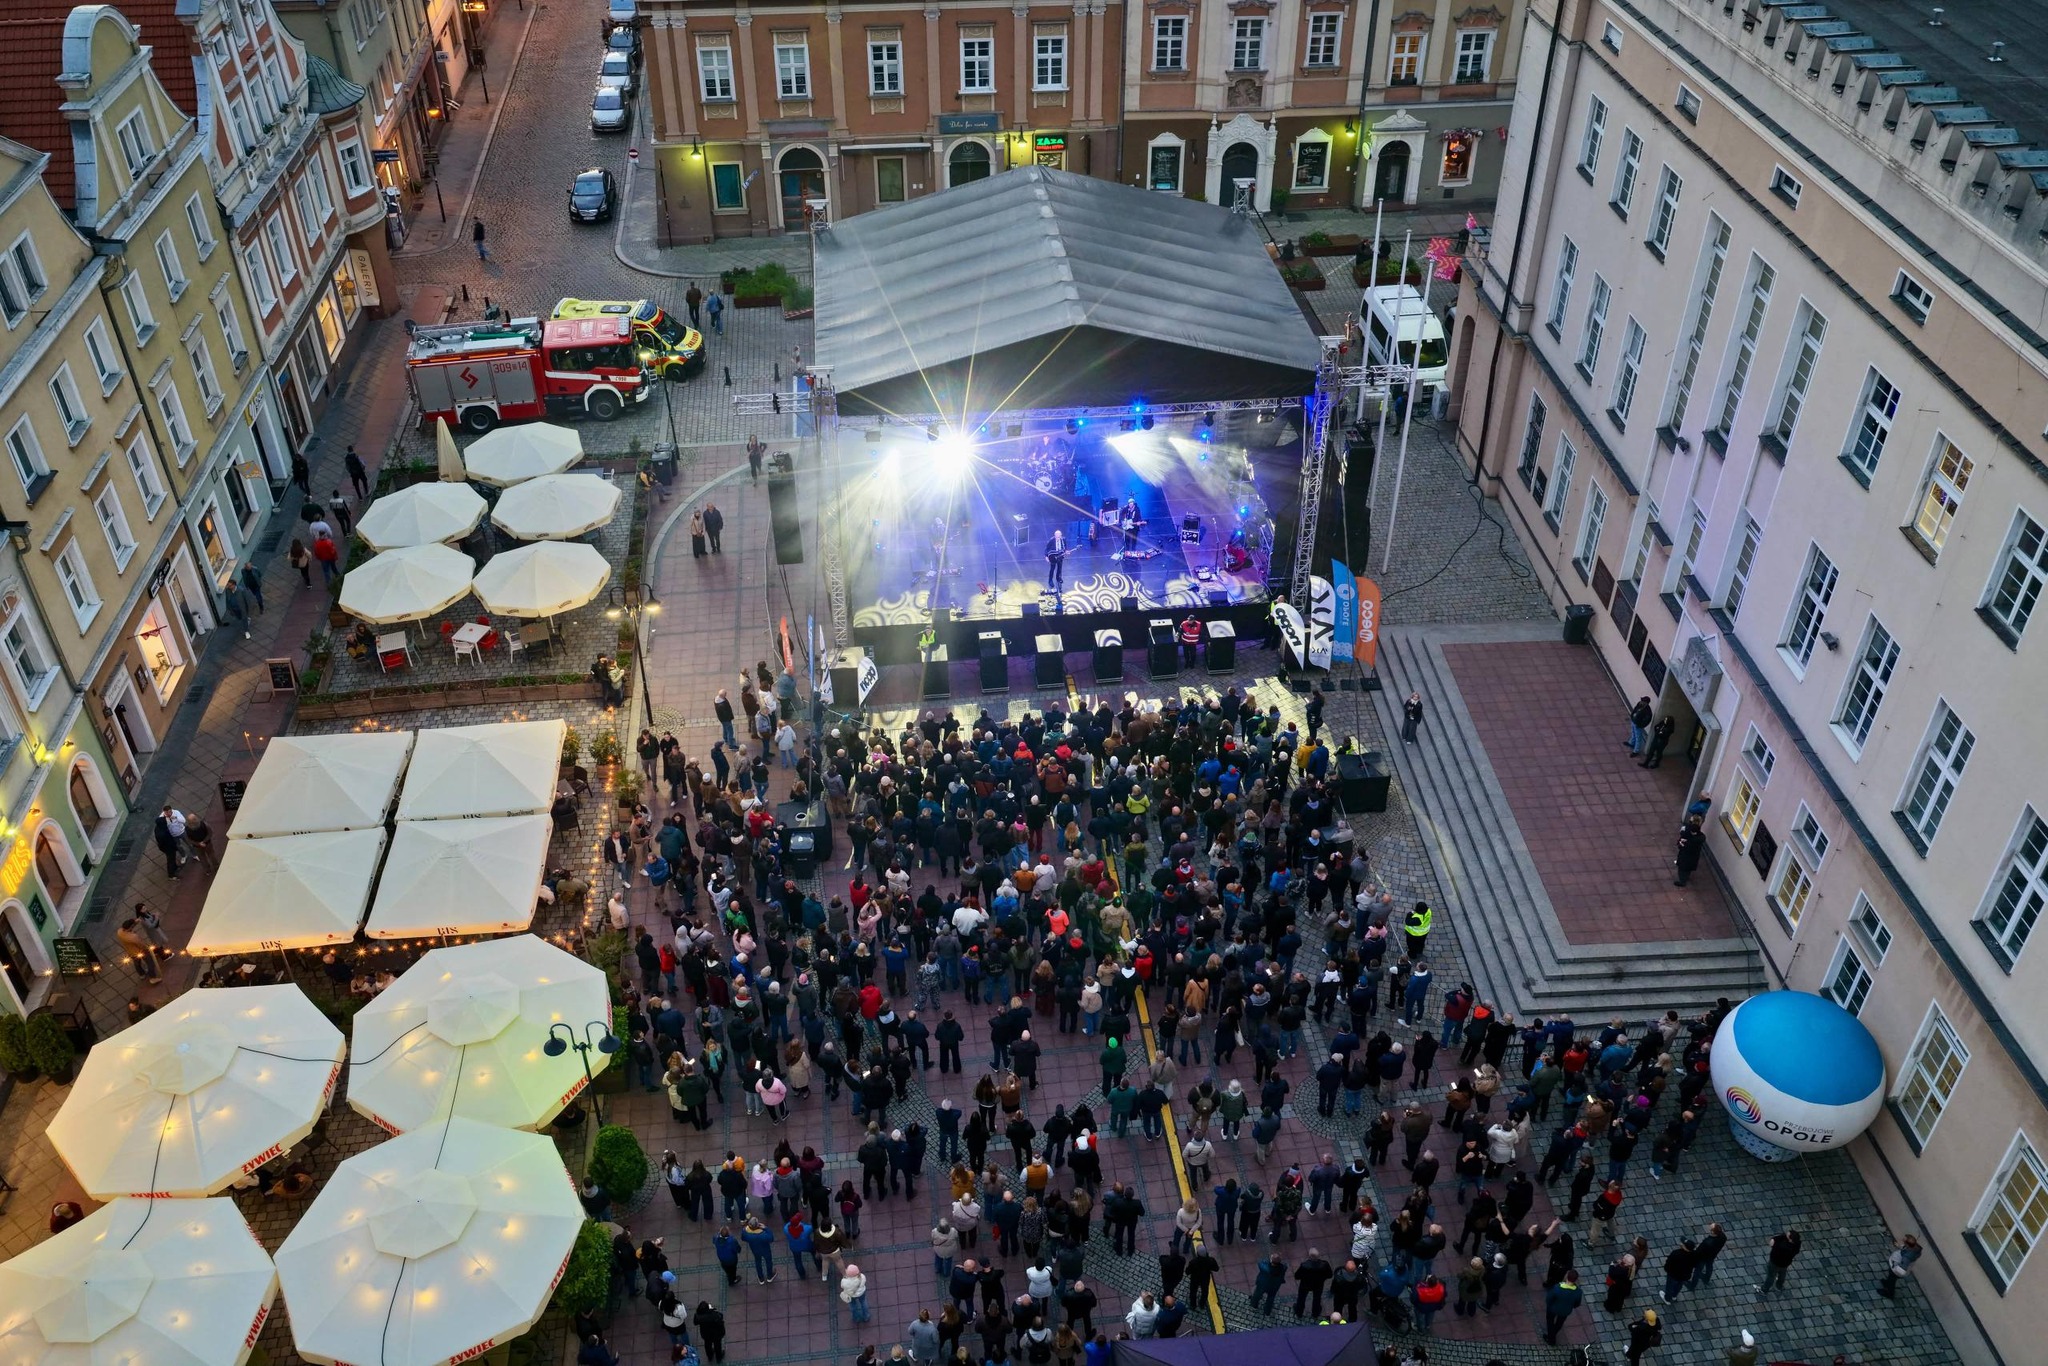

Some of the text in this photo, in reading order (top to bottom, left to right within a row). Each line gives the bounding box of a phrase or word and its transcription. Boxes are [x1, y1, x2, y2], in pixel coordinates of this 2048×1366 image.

[358, 255, 373, 297] GALERIA
[1764, 1120, 1833, 1144] OPOLE
[1784, 1121, 1835, 1134] PRZEBOJOWE
